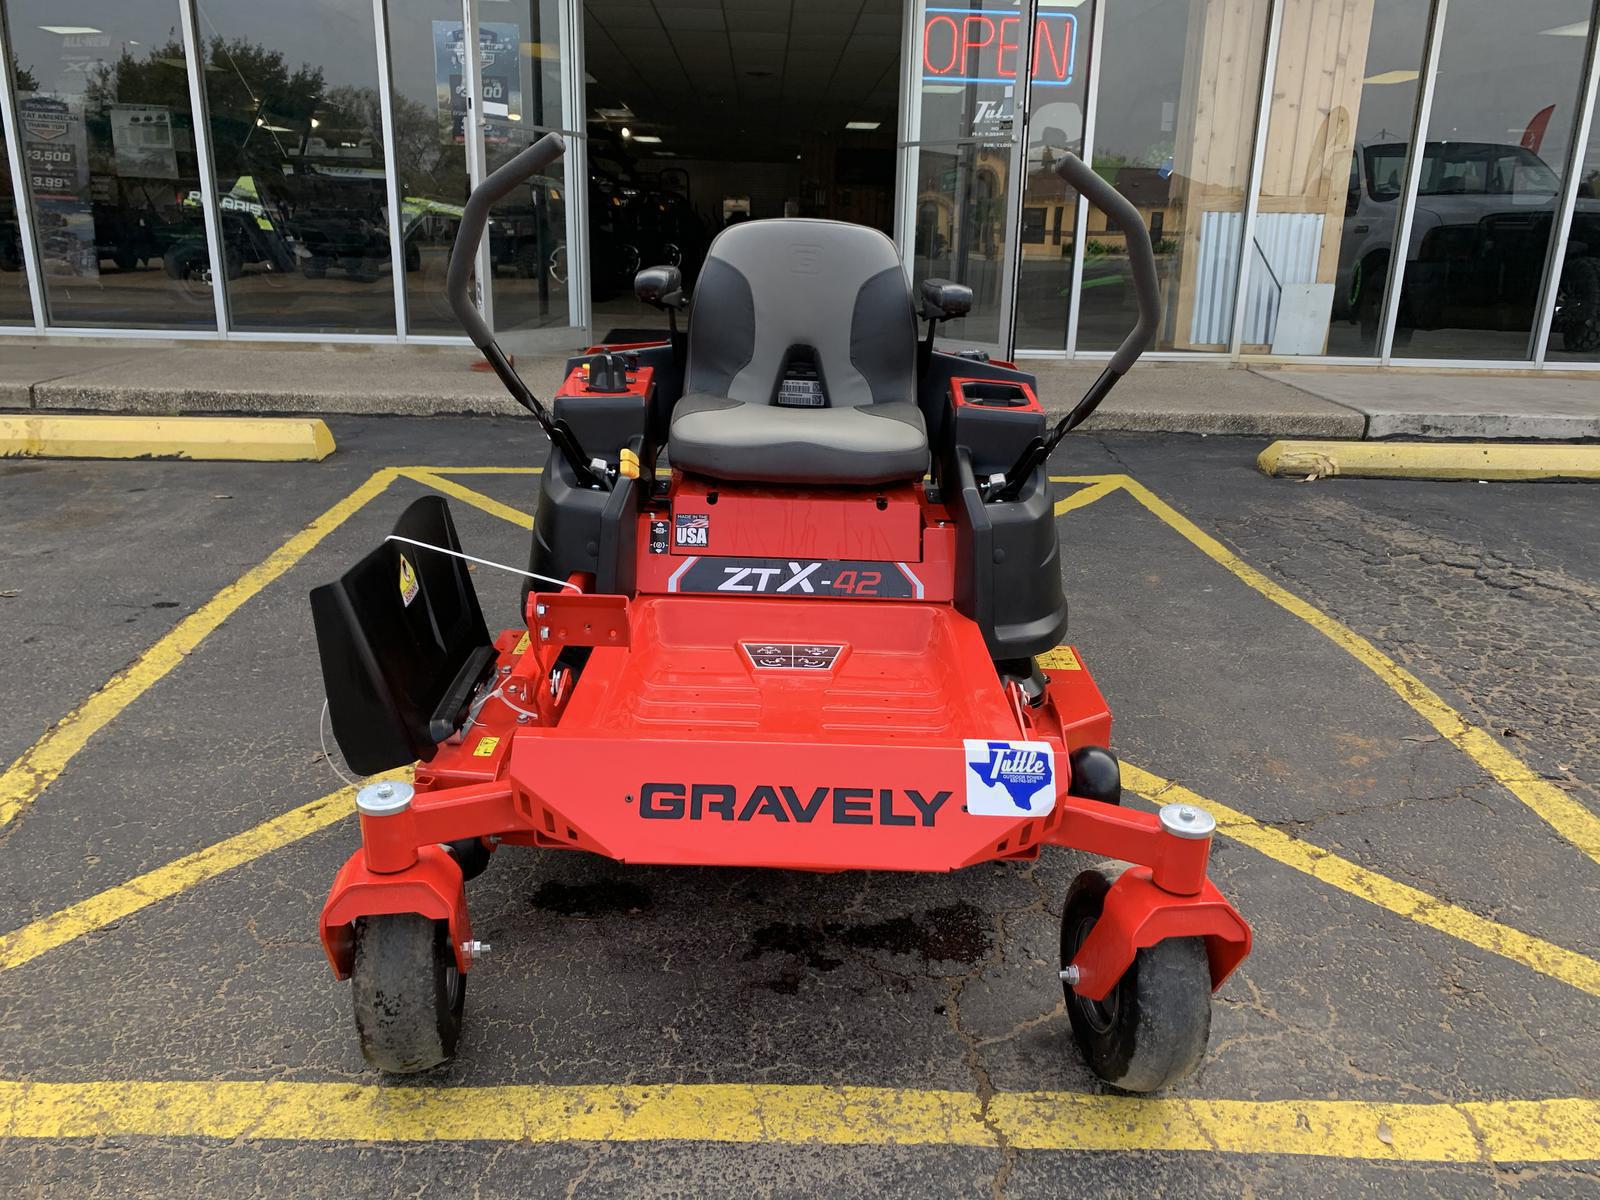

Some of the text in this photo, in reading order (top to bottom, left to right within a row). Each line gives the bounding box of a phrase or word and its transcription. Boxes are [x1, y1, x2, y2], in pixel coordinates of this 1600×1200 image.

[924, 16, 1071, 78] OPEN
[26, 150, 71, 162] $3,500
[187, 191, 263, 216] PARIS
[676, 527, 707, 544] USA
[989, 748, 1045, 779] Tuttle
[639, 782, 954, 828] GRAVELY
